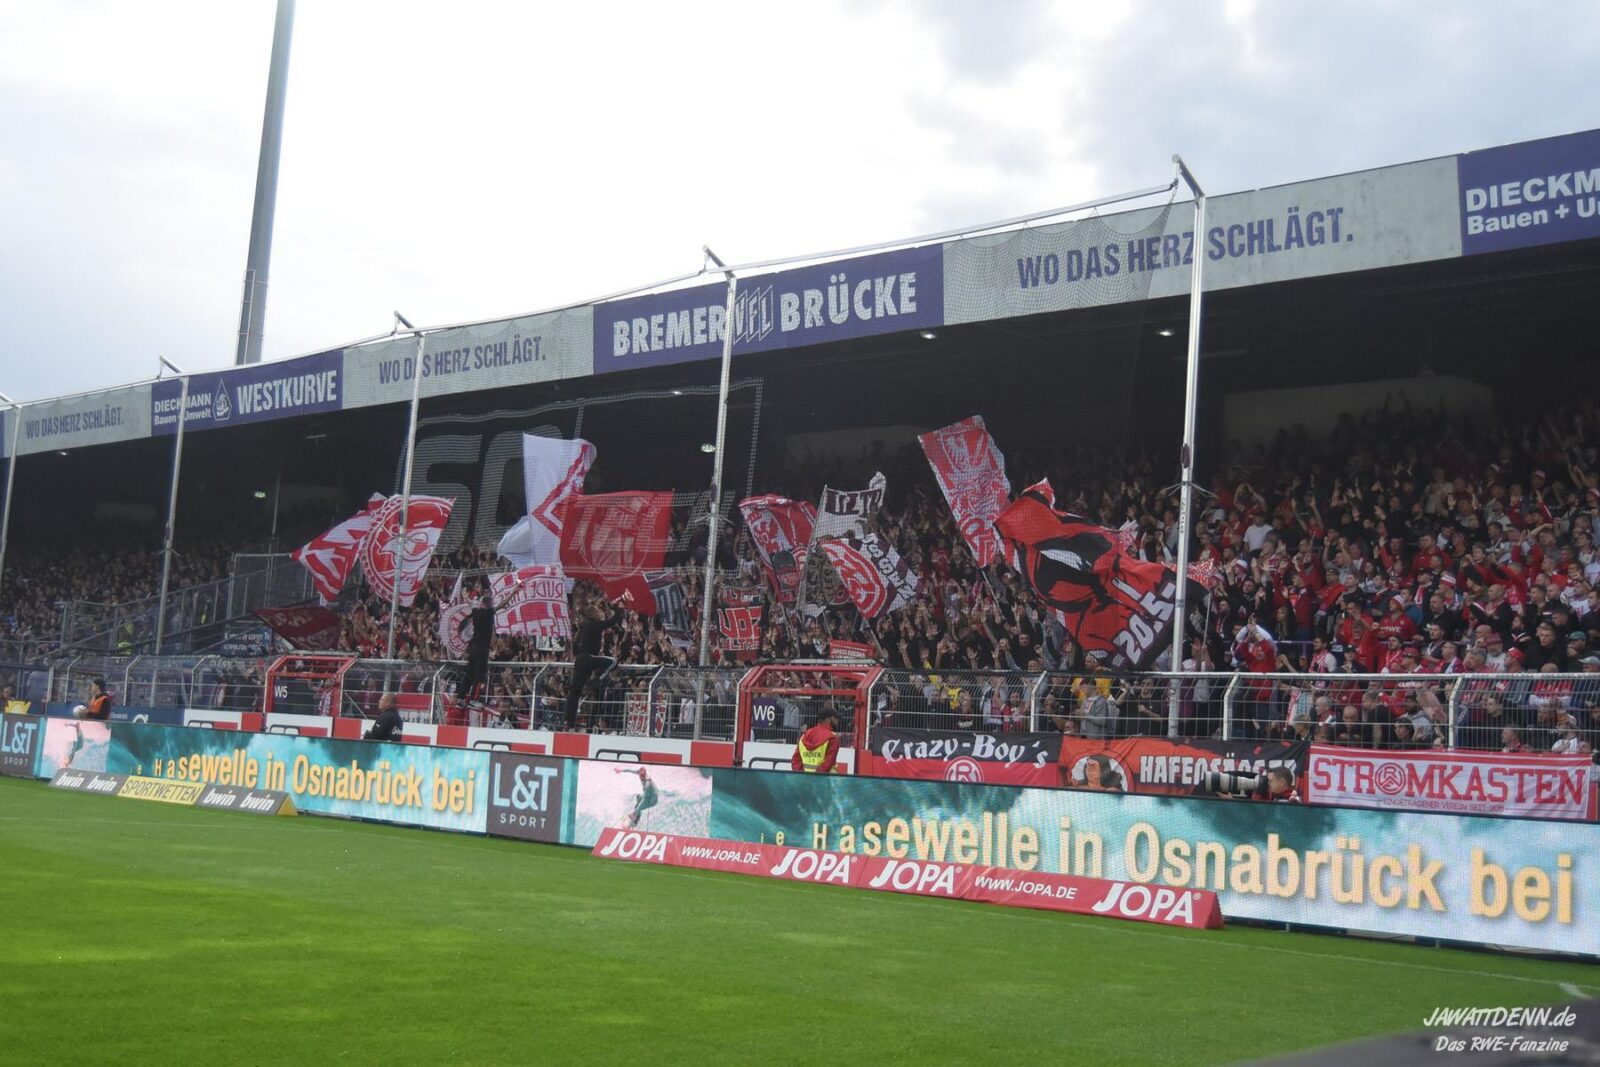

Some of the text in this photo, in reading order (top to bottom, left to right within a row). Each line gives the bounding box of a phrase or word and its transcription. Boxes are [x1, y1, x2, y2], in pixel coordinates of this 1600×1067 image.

[1466, 168, 1600, 212] DIECKM
[1467, 197, 1600, 235] Bauen + U
[1017, 206, 1353, 289] WO DAS HERZ SCHLÄGT.
[780, 272, 917, 332] BRÜCKE
[613, 305, 727, 357] BREMER
[379, 359, 400, 384] WO
[435, 347, 470, 376] HERZ
[474, 334, 546, 370] SCHLÄGT.
[237, 370, 337, 416] WESTKURVE
[26, 404, 125, 439] WO DAS HERZ SCHLÄGT.
[154, 415, 177, 426] Bauen
[274, 685, 288, 698] W5
[753, 704, 775, 721] W6
[1, 721, 37, 754] L&T
[4, 756, 29, 767] SPORT
[55, 772, 118, 792] bwin bwin
[121, 780, 199, 802] SPORTWETTEN
[154, 749, 258, 788] Hasewelle
[265, 752, 285, 792] in
[292, 754, 422, 808] Osnabrück
[433, 767, 475, 814] bei
[493, 762, 558, 812] L&T
[203, 788, 275, 811] bwin bwin
[500, 812, 547, 829] SPORT
[682, 845, 760, 866] WWW.JOPA.DE
[813, 811, 1039, 871] Hasewelle
[1059, 815, 1101, 878] in
[1125, 821, 1446, 912] Osnabrück
[1470, 847, 1572, 924] bei
[974, 874, 1078, 900] WWW.JOPA.DE
